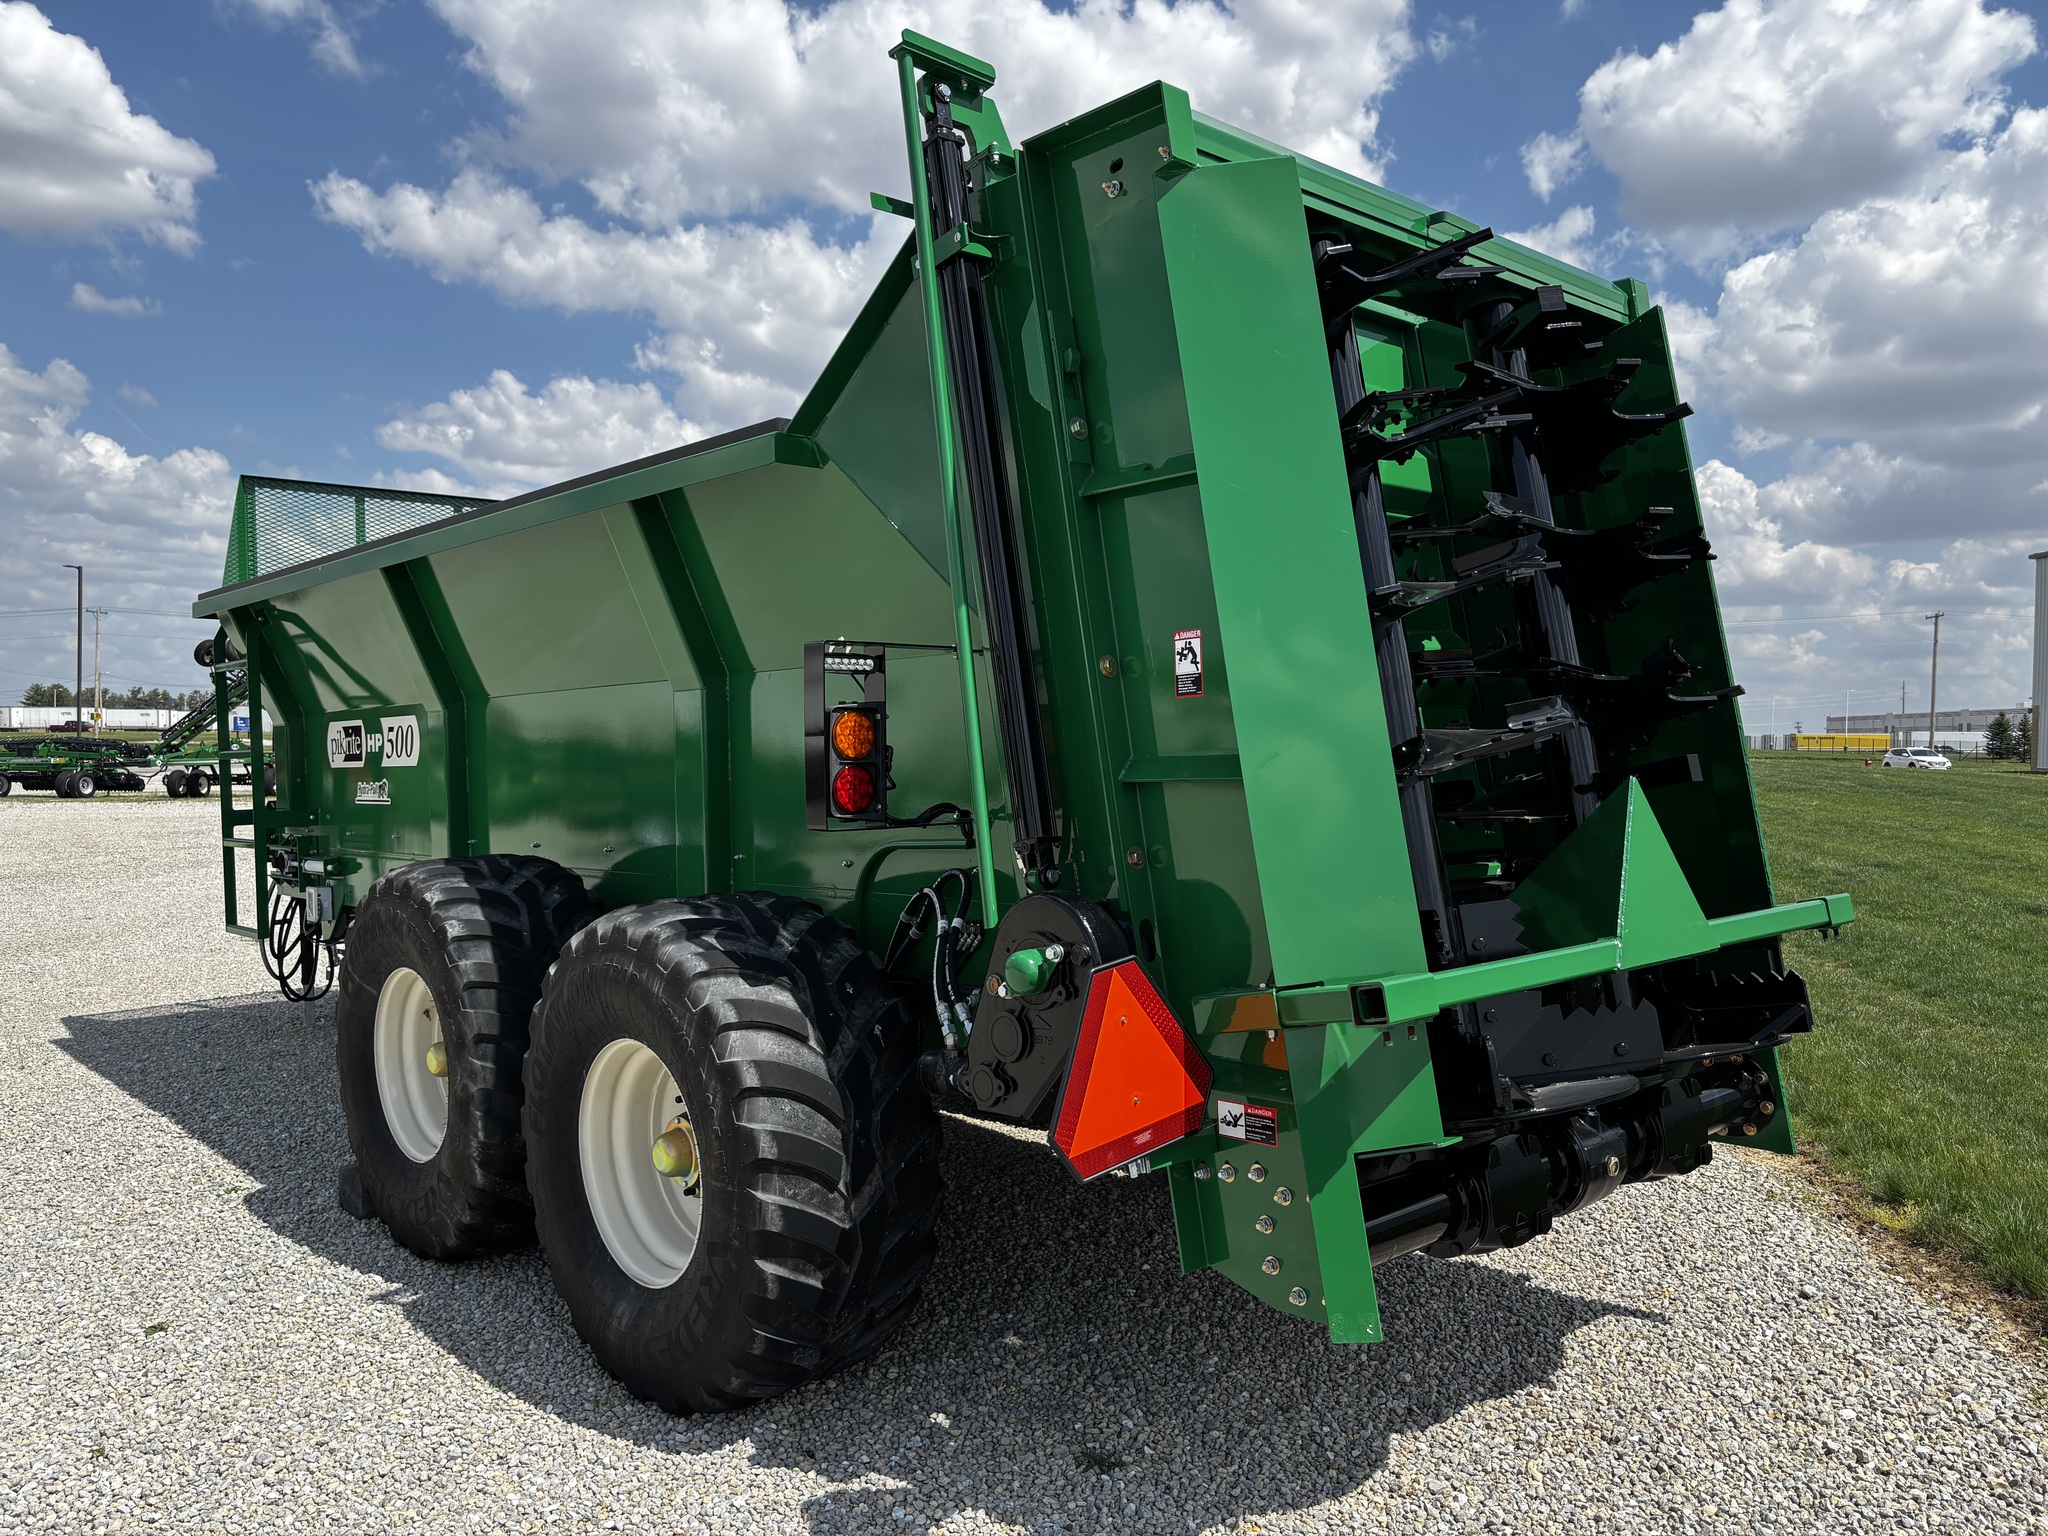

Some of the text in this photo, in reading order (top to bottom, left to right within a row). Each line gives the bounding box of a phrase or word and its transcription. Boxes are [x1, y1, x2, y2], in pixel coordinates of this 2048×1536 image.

[1180, 629, 1201, 639] DANGER
[367, 733, 383, 752] HP
[386, 725, 414, 759] 500
[1251, 1108, 1272, 1117] DANGER
